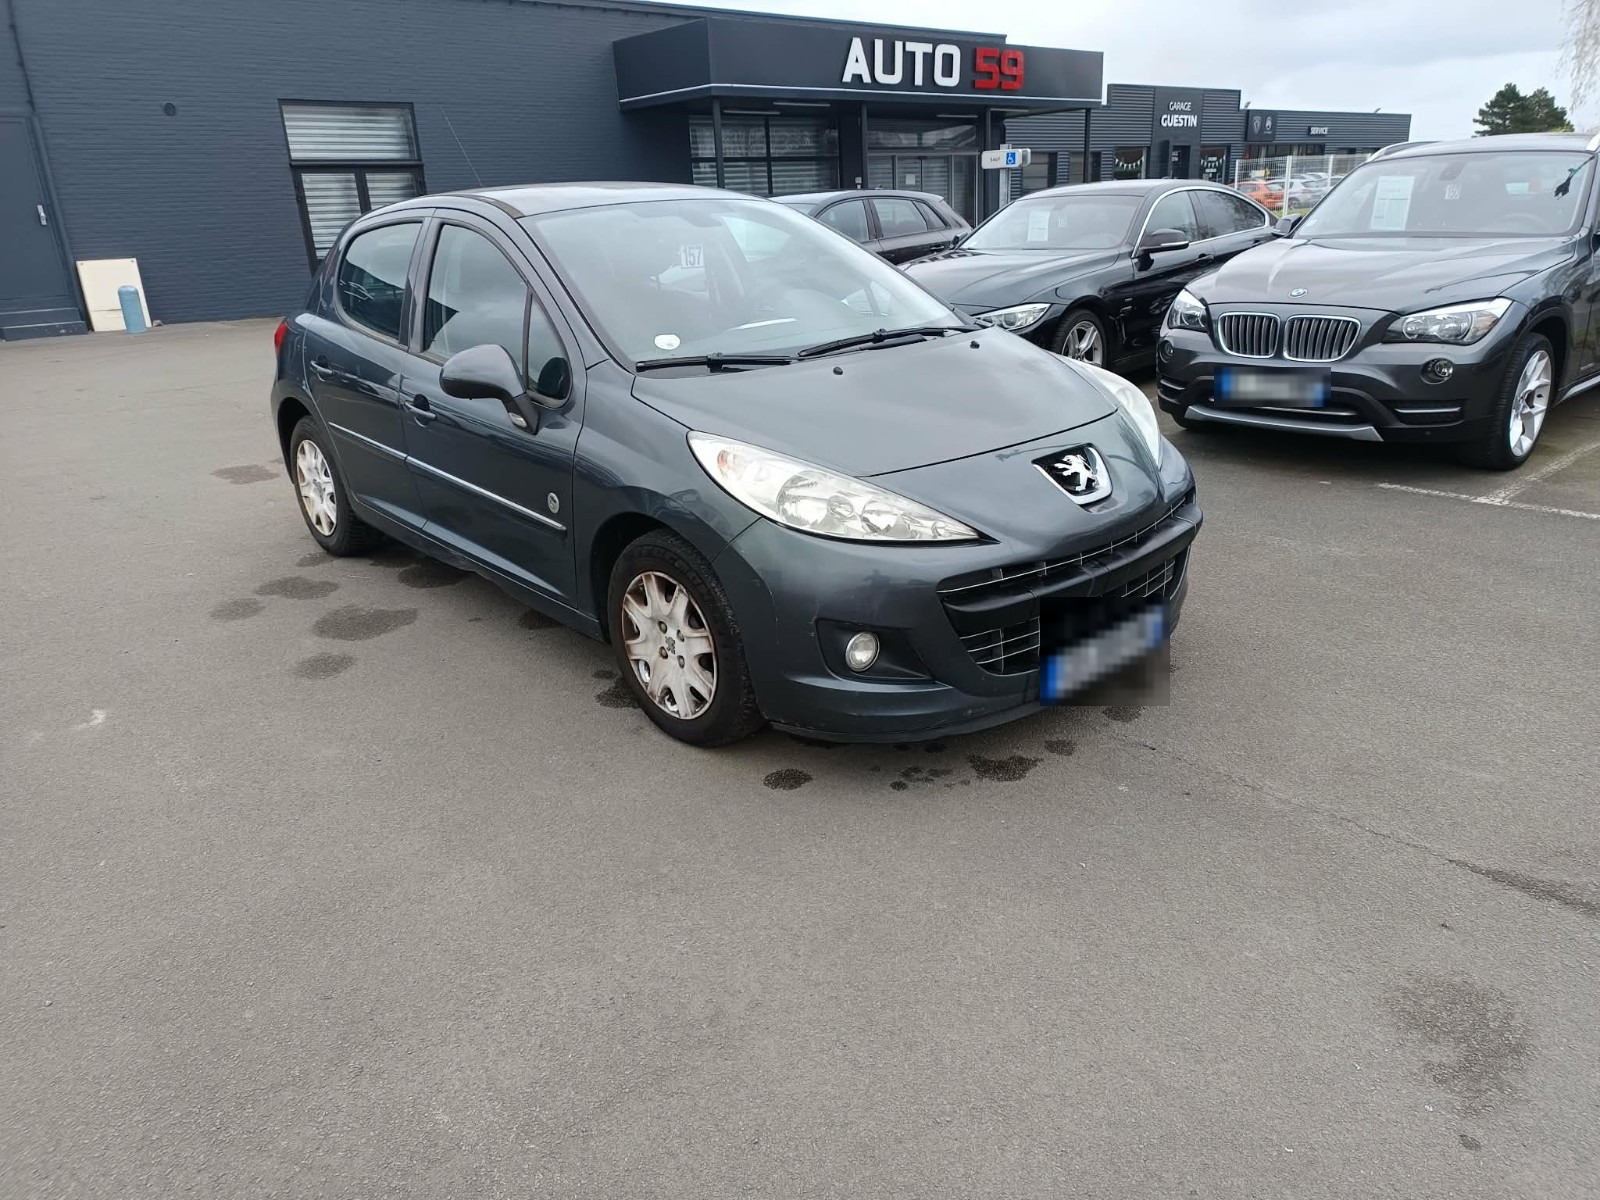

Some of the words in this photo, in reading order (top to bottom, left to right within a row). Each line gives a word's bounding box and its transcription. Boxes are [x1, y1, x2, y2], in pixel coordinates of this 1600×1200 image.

[842, 37, 961, 87] AUTO
[974, 47, 1024, 90] 59
[1169, 101, 1192, 111] GARAGE
[1160, 114, 1198, 127] GUESTIN
[1310, 127, 1328, 135] SERVICE
[684, 245, 702, 266] 157
